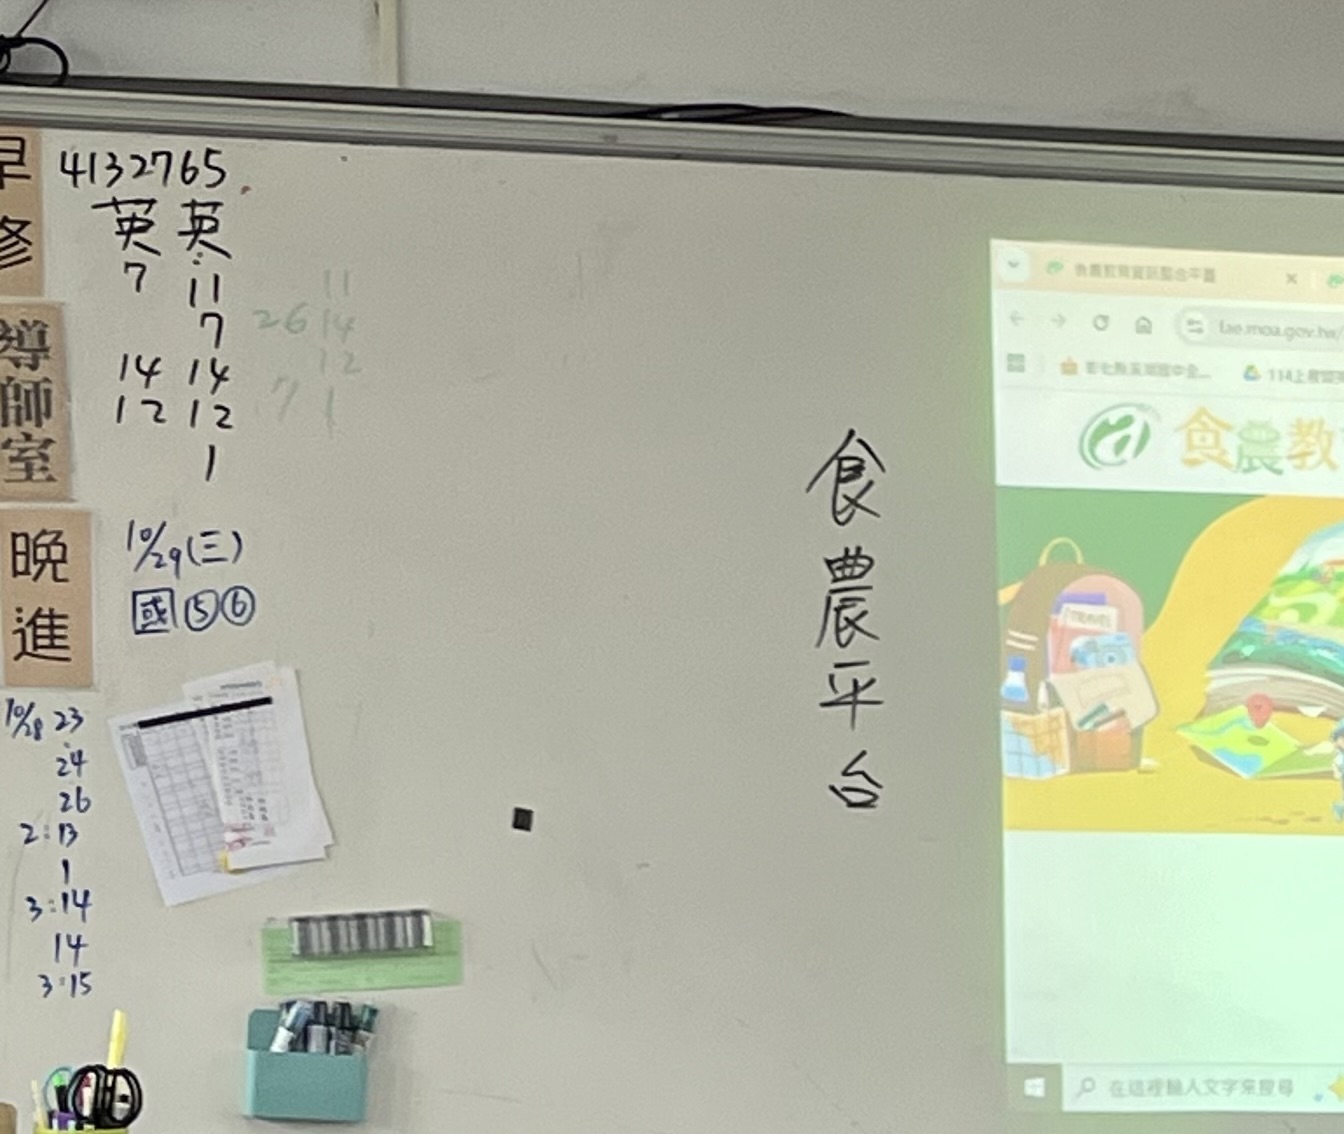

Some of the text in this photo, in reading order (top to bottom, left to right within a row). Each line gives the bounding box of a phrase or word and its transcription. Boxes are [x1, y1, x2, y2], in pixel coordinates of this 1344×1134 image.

[60, 148, 228, 188] 4132765
[92, 197, 161, 256] 英
[120, 354, 161, 389] 14
[189, 357, 229, 395] 14
[0, 318, 58, 484] 導師室
[116, 396, 166, 424] 12
[190, 400, 233, 429] 12
[11, 529, 71, 662] 晚進
[805, 428, 887, 810] 食農平台
